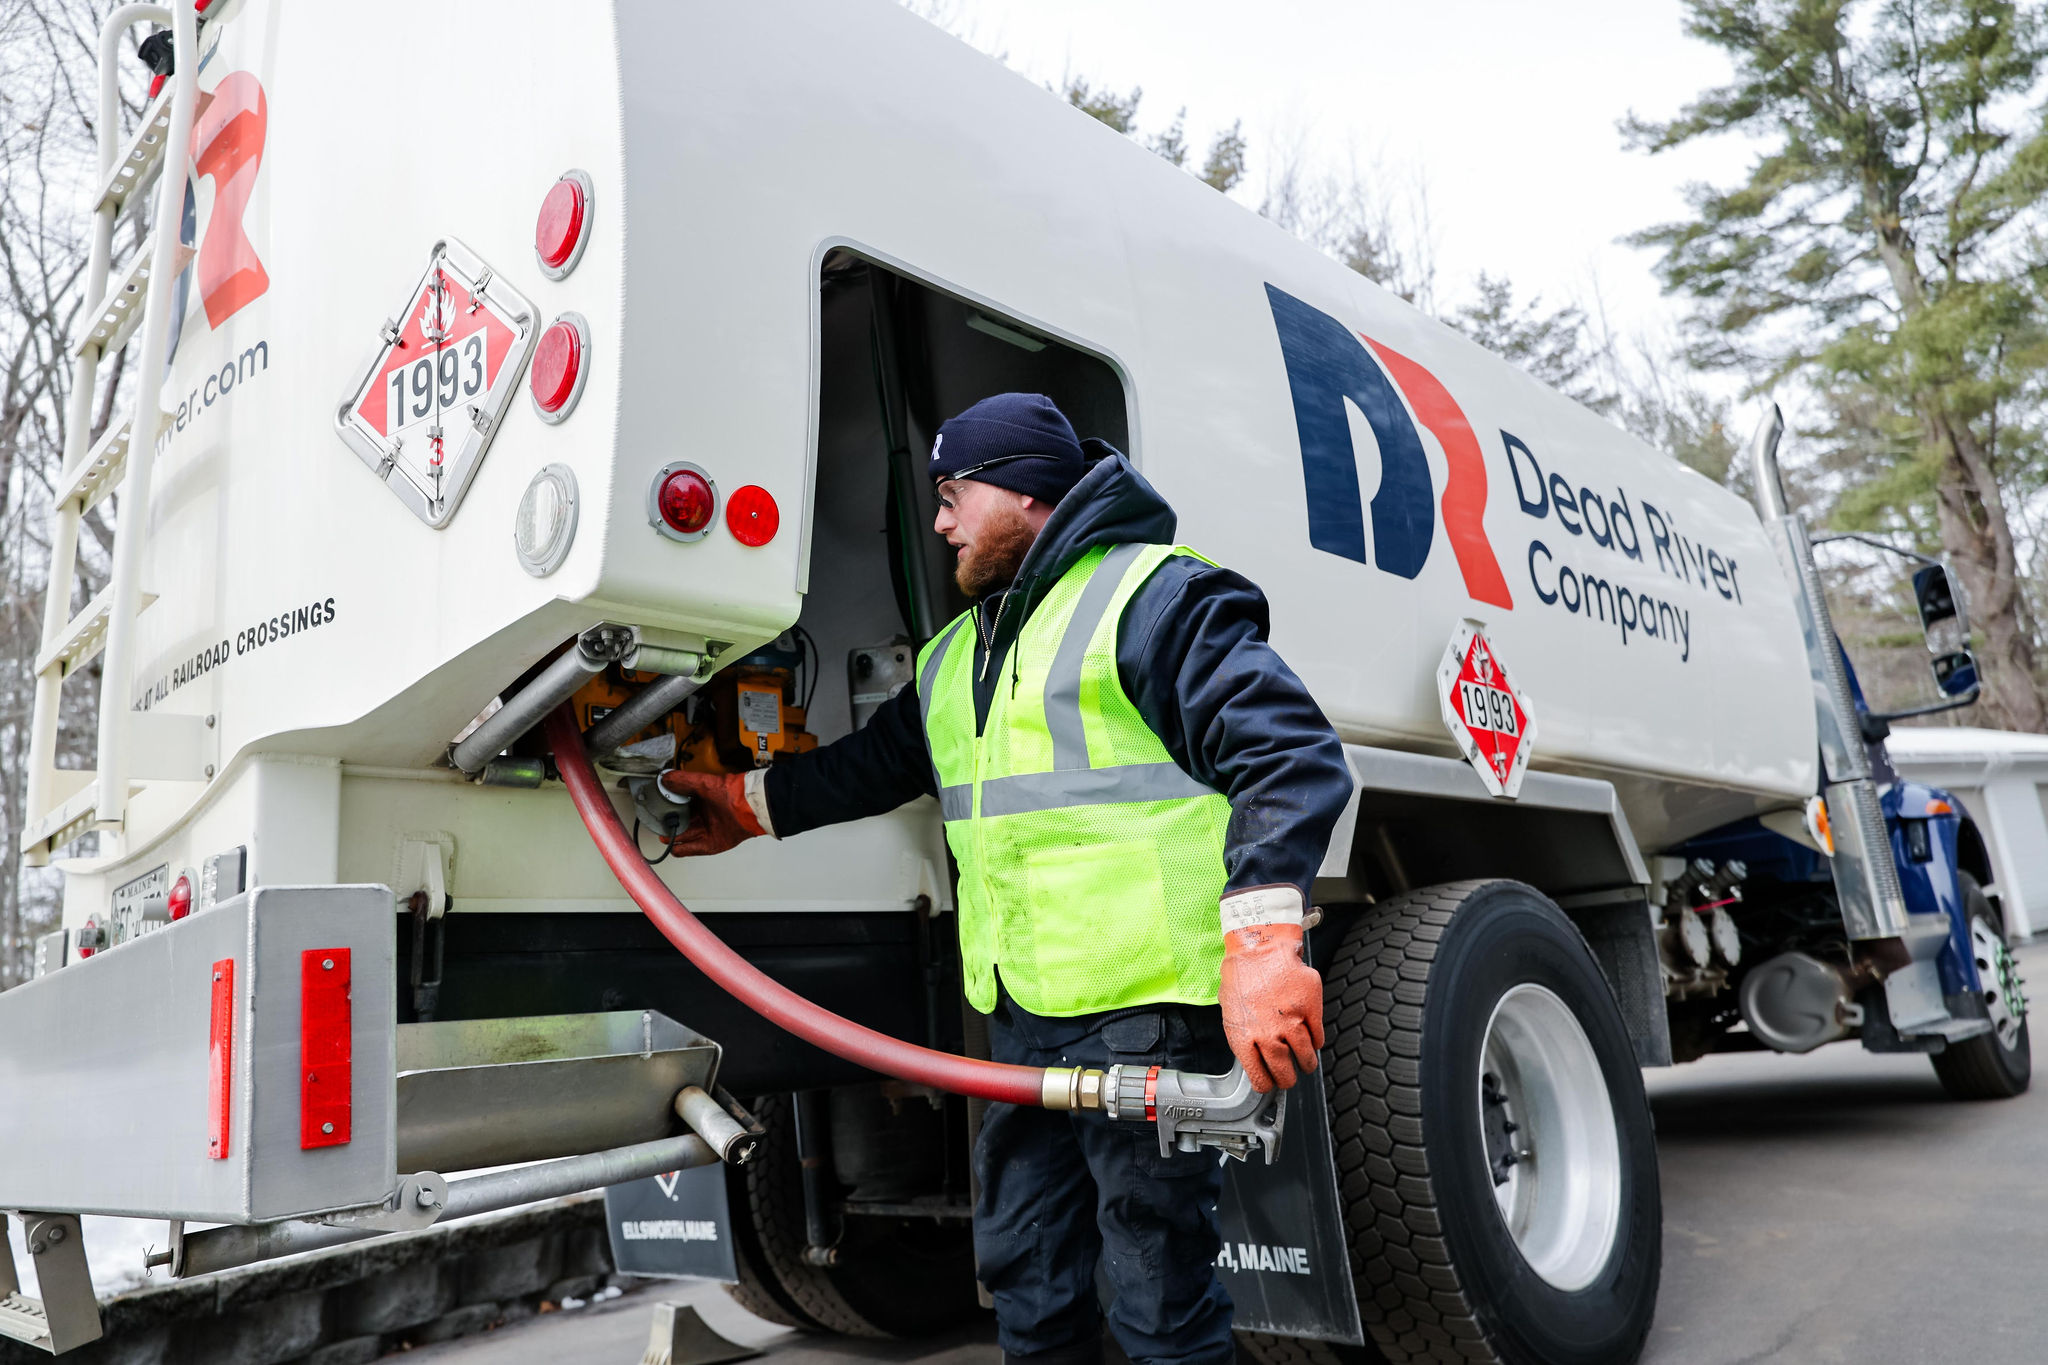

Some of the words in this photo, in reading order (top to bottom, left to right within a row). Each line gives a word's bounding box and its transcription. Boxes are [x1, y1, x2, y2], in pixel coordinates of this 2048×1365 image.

[391, 335, 483, 428] 1993
[429, 438, 444, 466] 3
[1499, 428, 1644, 563] Dead
[1641, 500, 1742, 605] River
[1528, 540, 1689, 662] Company
[144, 687, 153, 712] AT
[155, 675, 169, 704] ALL
[173, 640, 230, 691] RAILROAD
[236, 597, 335, 656] CROSSINGS
[1462, 684, 1515, 734] 1993
[128, 877, 153, 898] MAINE
[1238, 1242, 1310, 1275] MAINE
